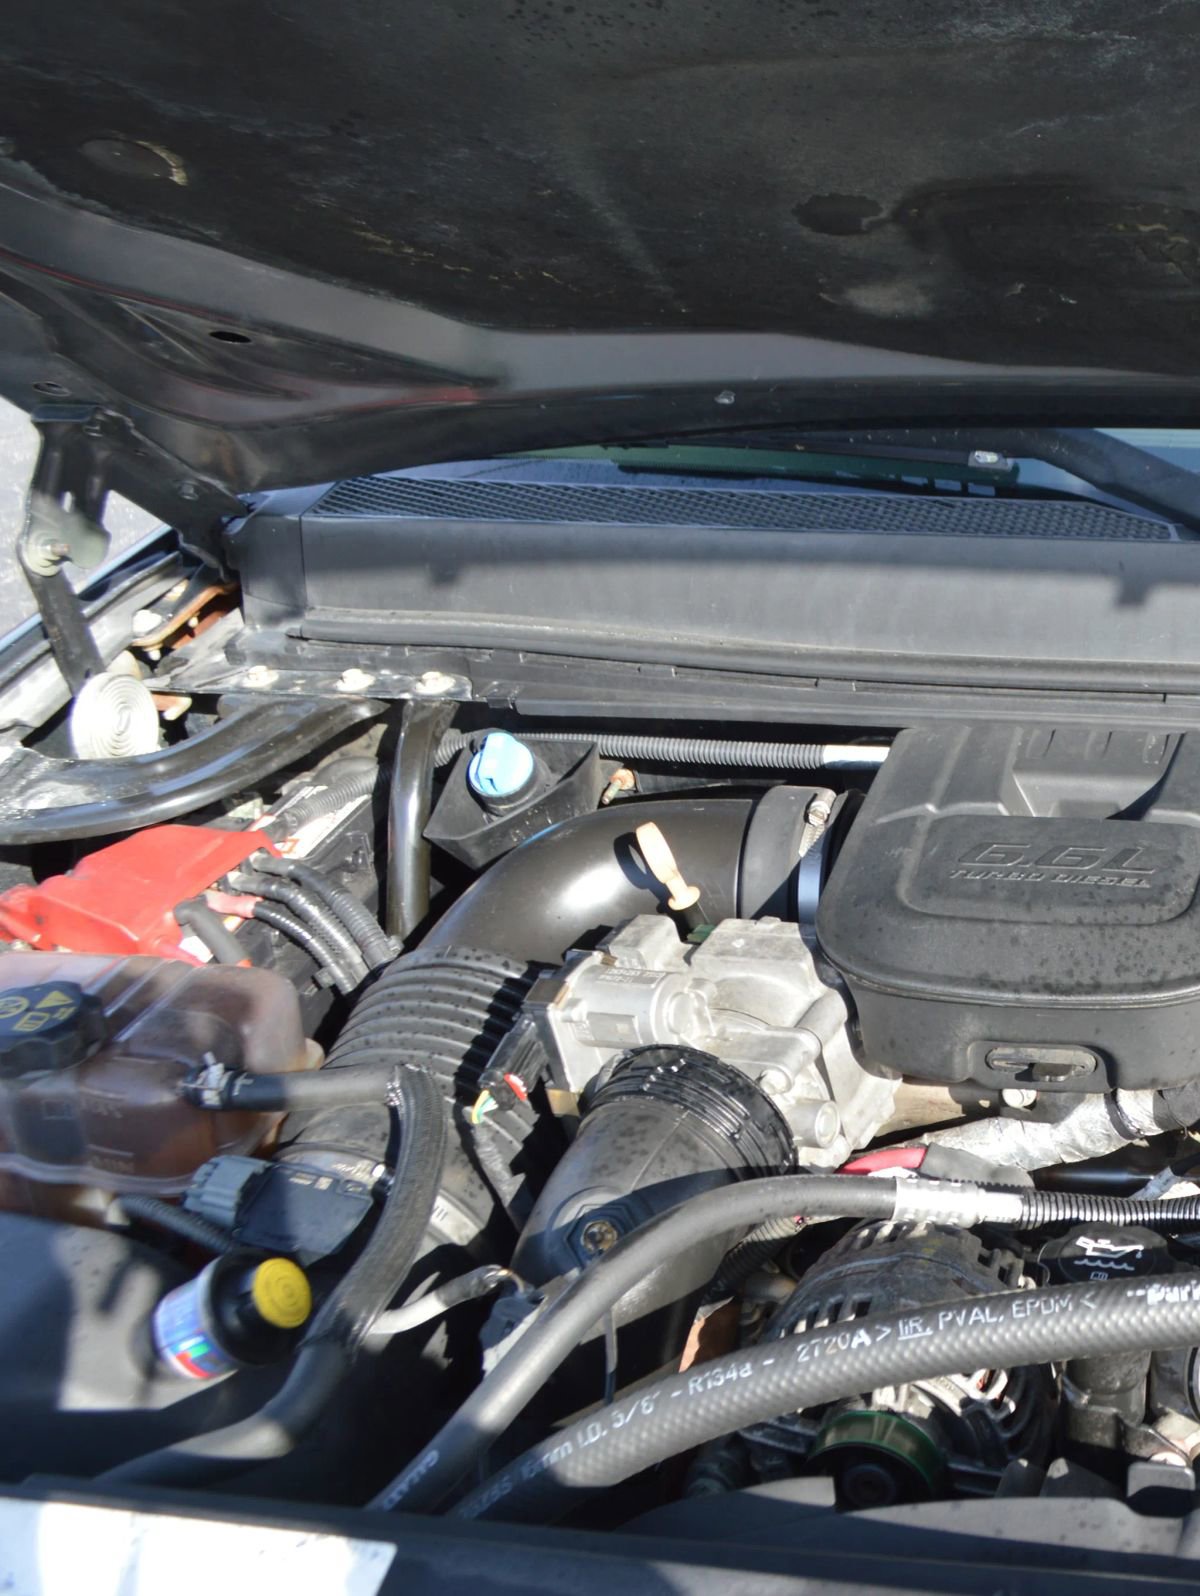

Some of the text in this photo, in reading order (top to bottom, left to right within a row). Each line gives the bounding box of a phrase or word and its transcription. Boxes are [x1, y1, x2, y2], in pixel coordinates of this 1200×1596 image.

[958, 842, 1156, 874] 6.6L
[950, 869, 1152, 889] TURBO DIESEL
[688, 1361, 754, 1396] R134a
